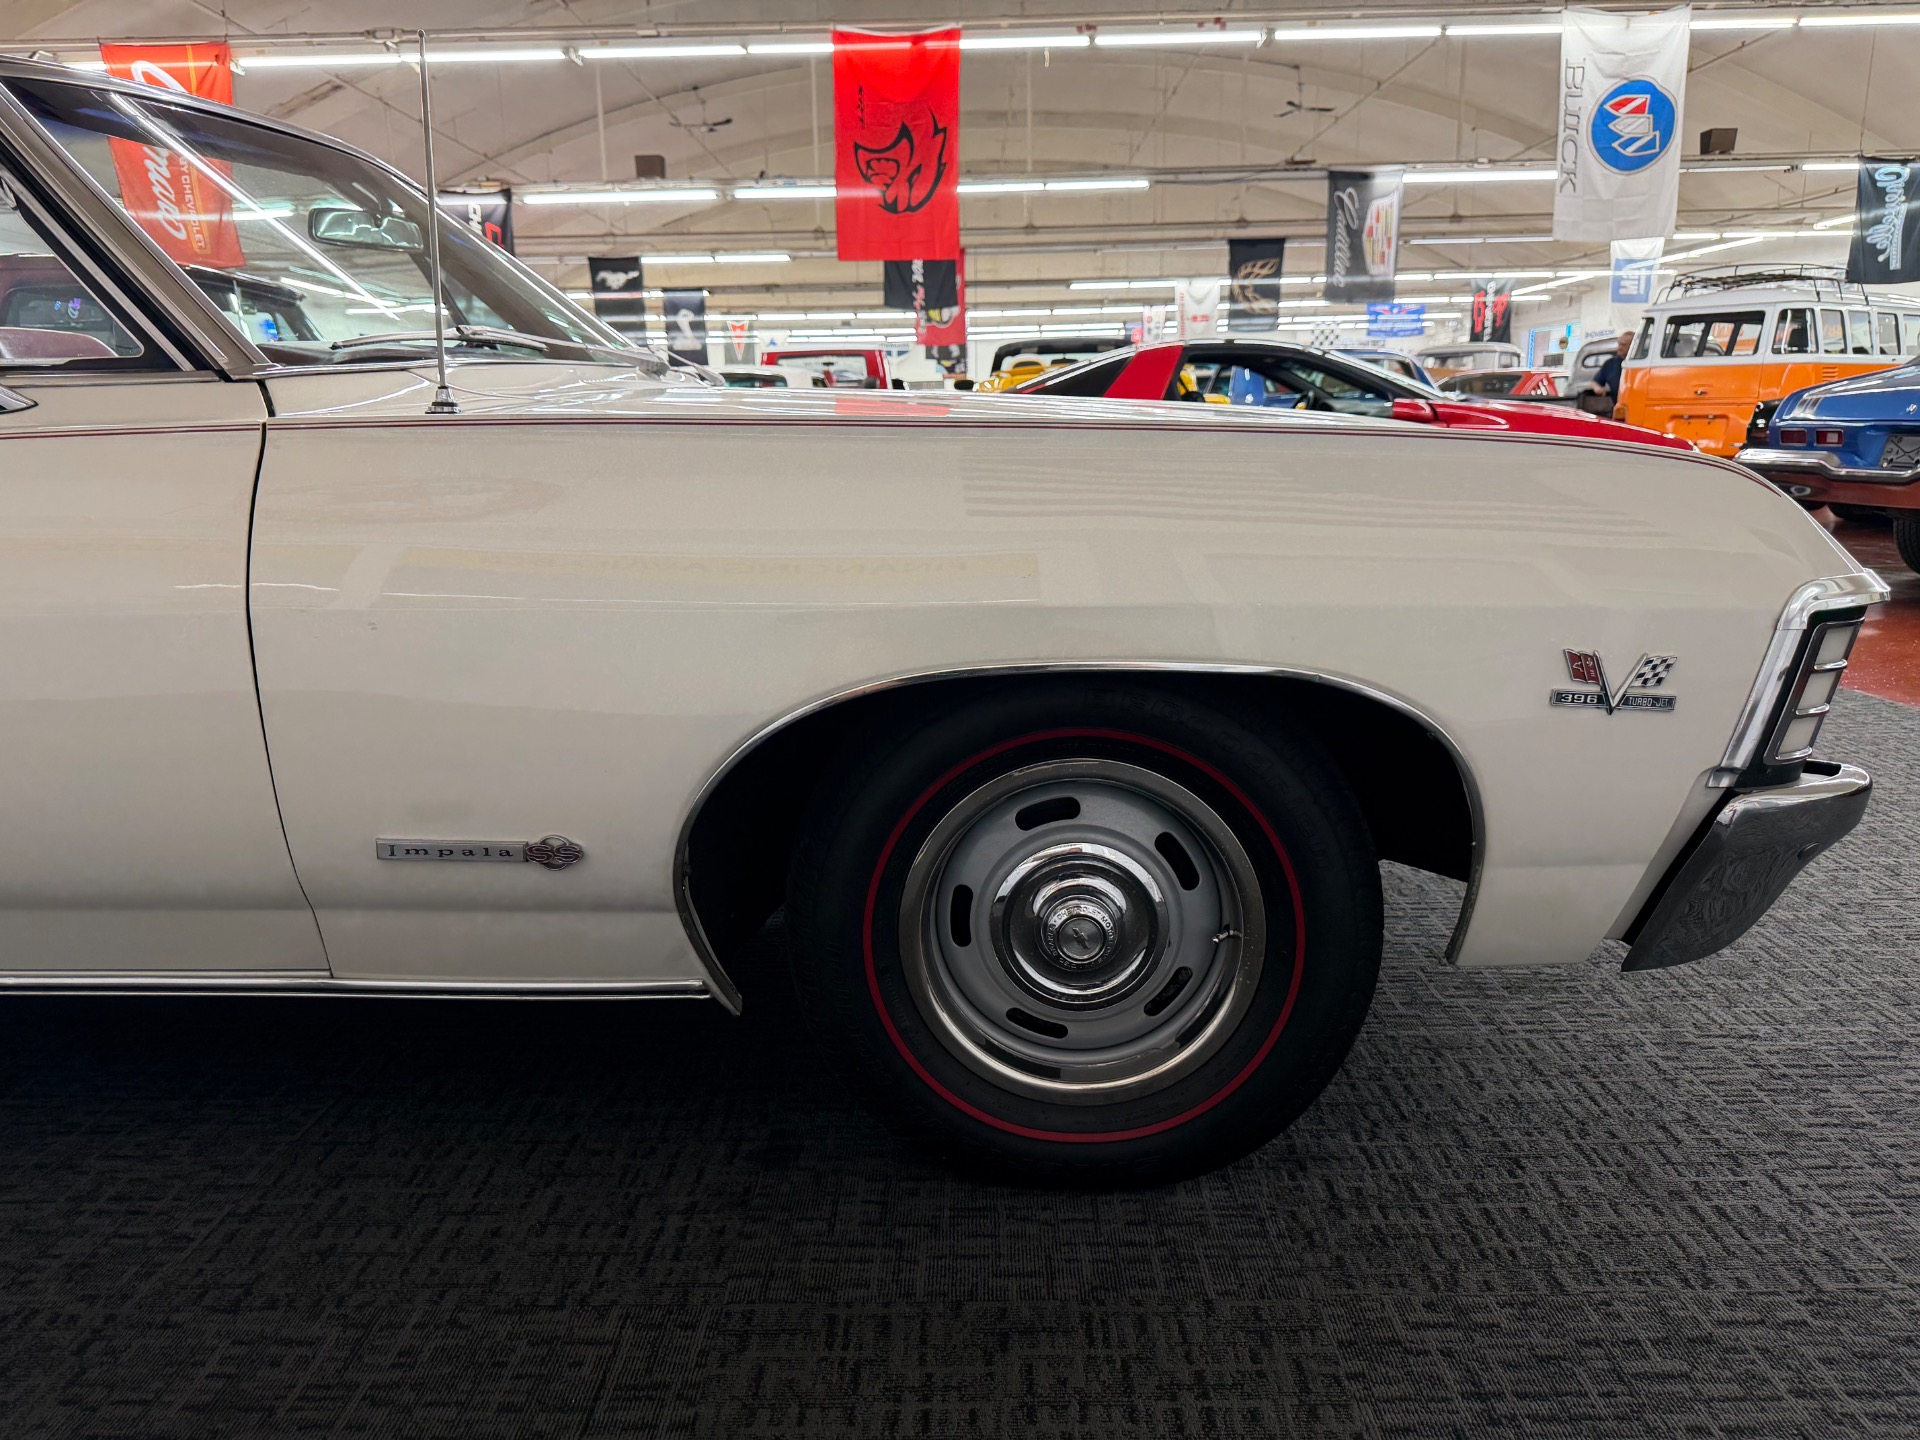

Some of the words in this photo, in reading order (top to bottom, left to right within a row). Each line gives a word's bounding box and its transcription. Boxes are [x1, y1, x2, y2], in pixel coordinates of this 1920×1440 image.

[1559, 57, 1586, 194] BUICK
[1333, 187, 1360, 288] Cadillac
[1560, 693, 1598, 705] 396
[1629, 696, 1669, 708] TURBO-JET
[387, 844, 514, 858] Impala
[1057, 905, 1102, 922] CHEVROLET
